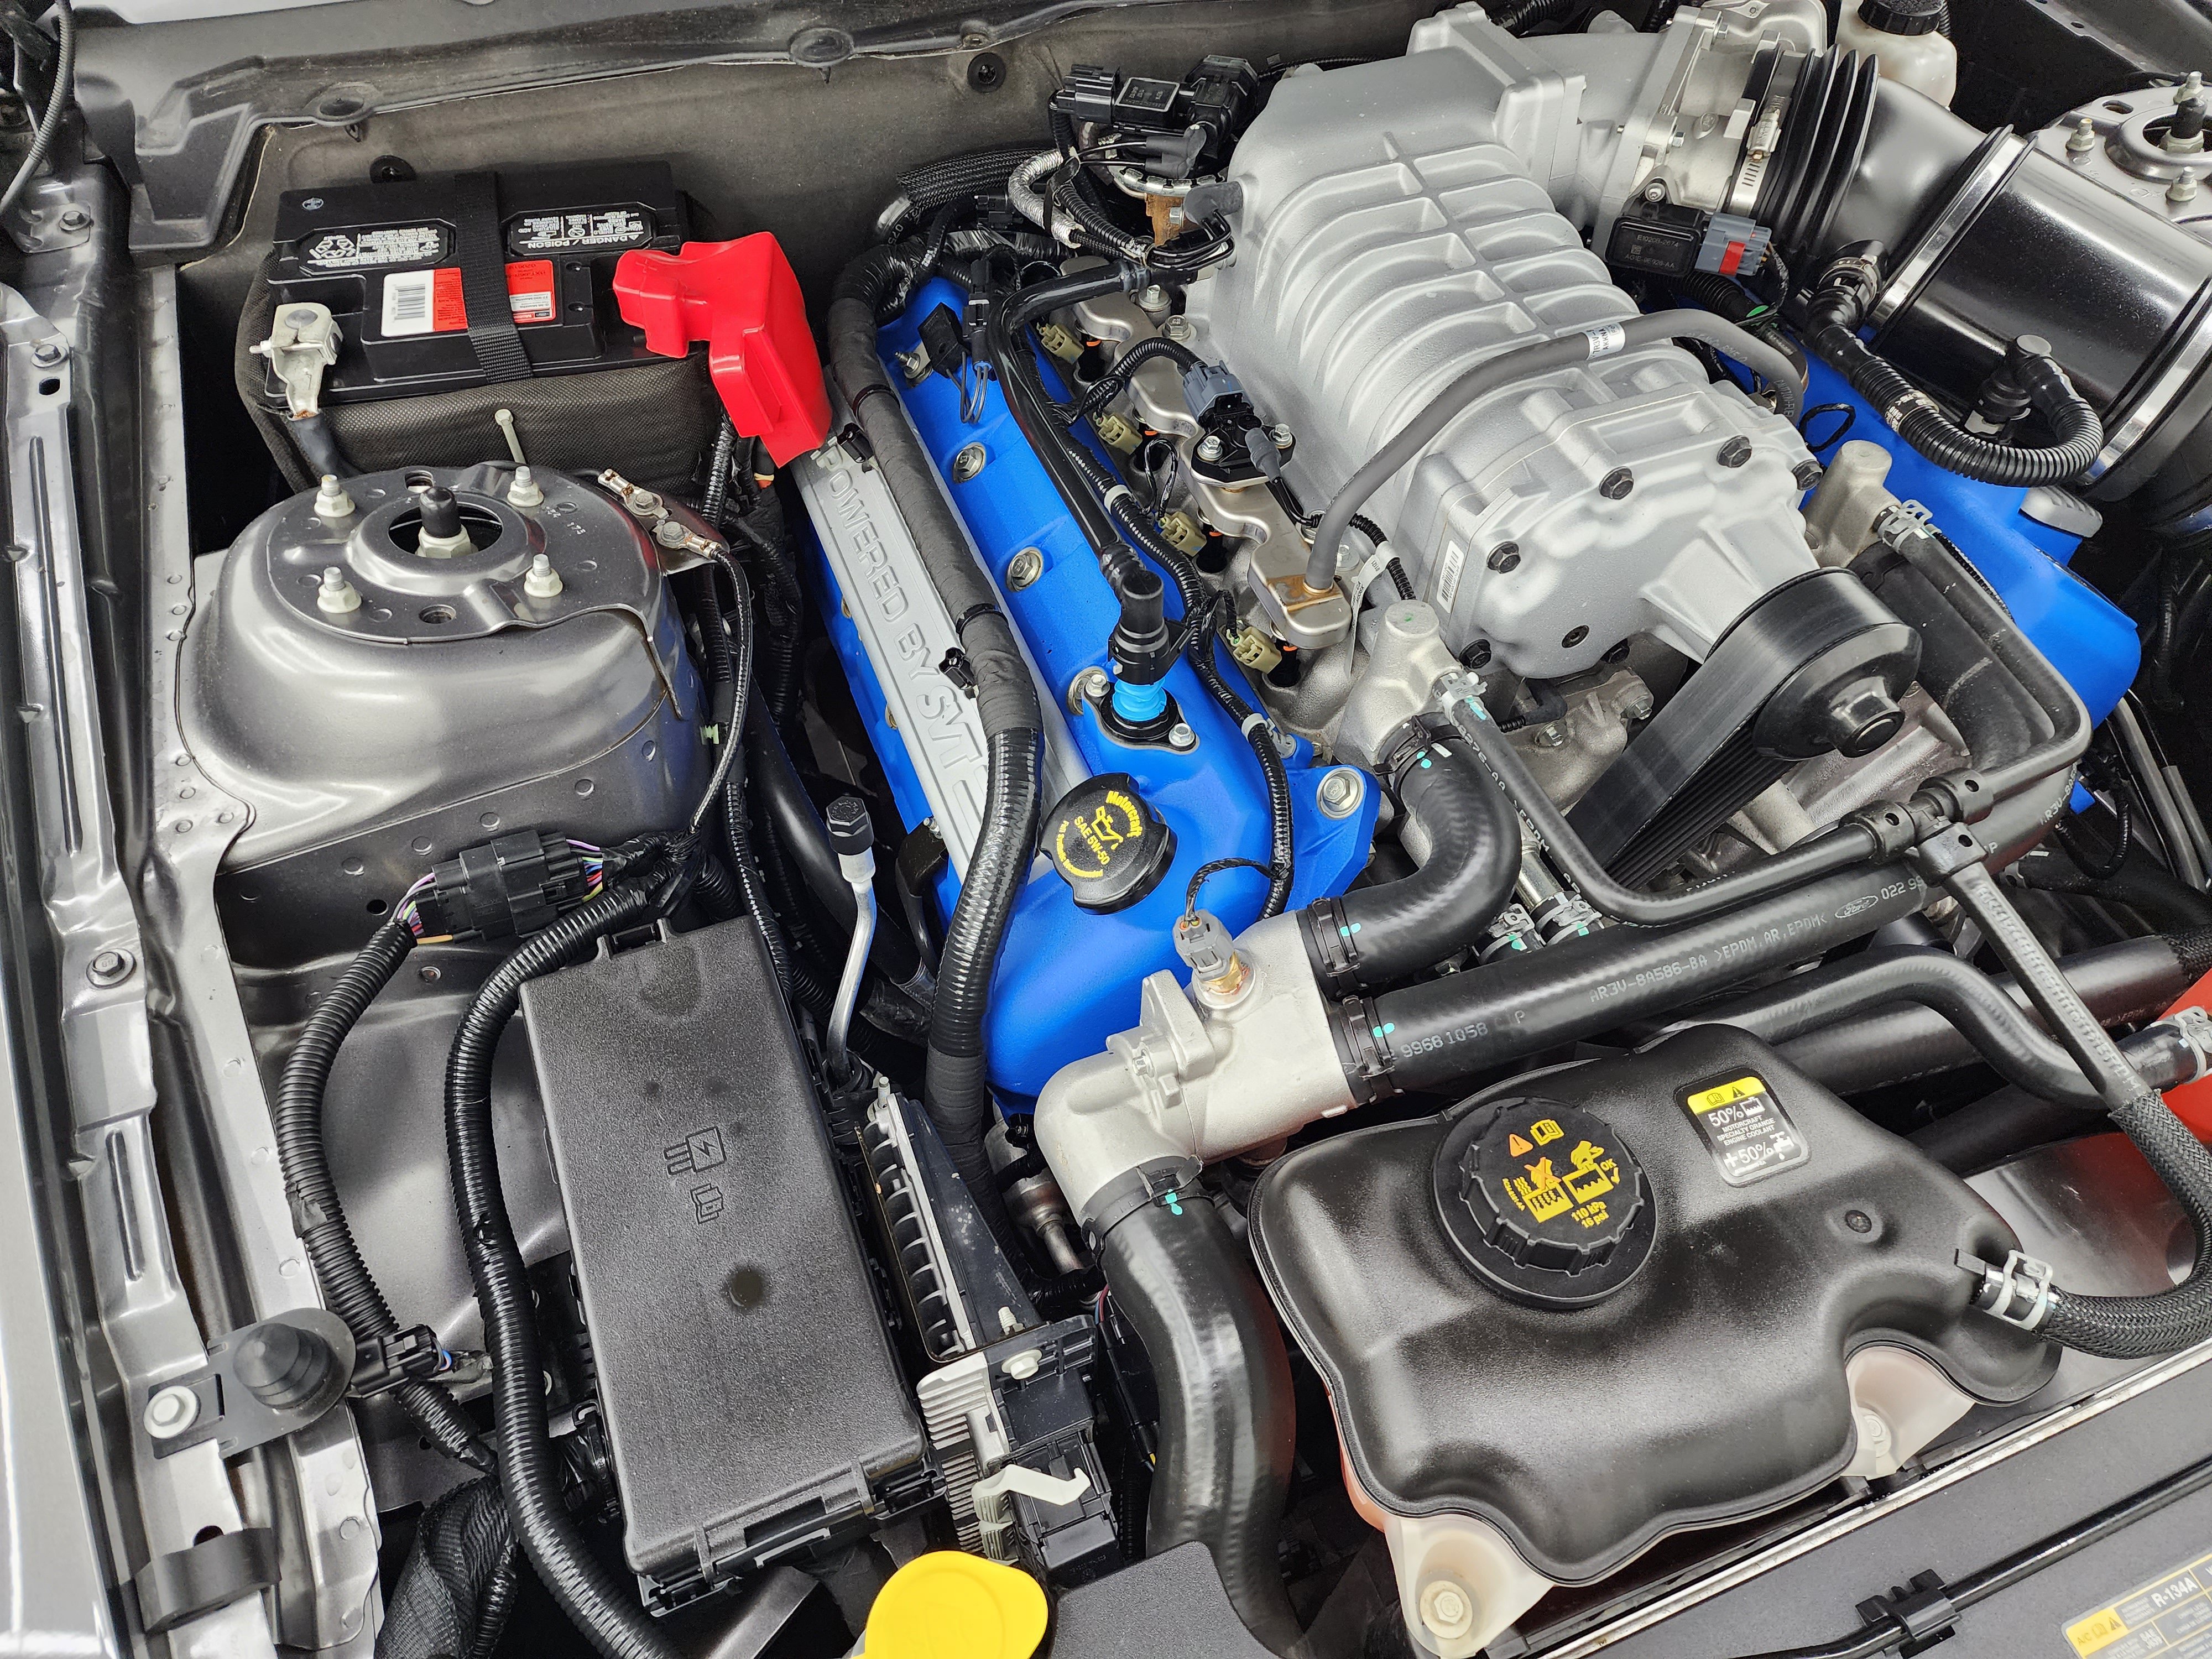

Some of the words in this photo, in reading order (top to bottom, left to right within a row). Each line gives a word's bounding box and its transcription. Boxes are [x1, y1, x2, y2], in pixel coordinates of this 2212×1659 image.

[528, 239, 569, 248] POISON
[581, 235, 627, 244] DANGER
[820, 452, 909, 623] POWERED
[894, 623, 938, 681] BY
[916, 685, 984, 771] SVT
[1105, 790, 1142, 838] Motorcraft
[1074, 815, 1092, 838] SAE
[1087, 835, 1110, 865] 5W-50
[1400, 1035, 1444, 1059] 9968
[1445, 1021, 1489, 1045] 1058
[1881, 883, 1906, 900] 022
[1708, 1104, 1744, 1127] 50%
[1722, 1115, 1762, 1133] MOTORCRAFT
[1717, 1126, 1750, 1142] SPECIALTY
[1749, 1118, 1775, 1131] ORANGE
[1724, 1133, 1746, 1146] ENGINE
[1745, 1124, 1775, 1139] COOLANT
[1600, 1159, 1617, 1171] OK
[1571, 1208, 1589, 1222] 110
[1588, 1200, 1608, 1217] kPa
[1581, 1218, 1595, 1229] 16
[1594, 1210, 1609, 1226] psi
[2151, 1577, 2198, 1608] R-134A
